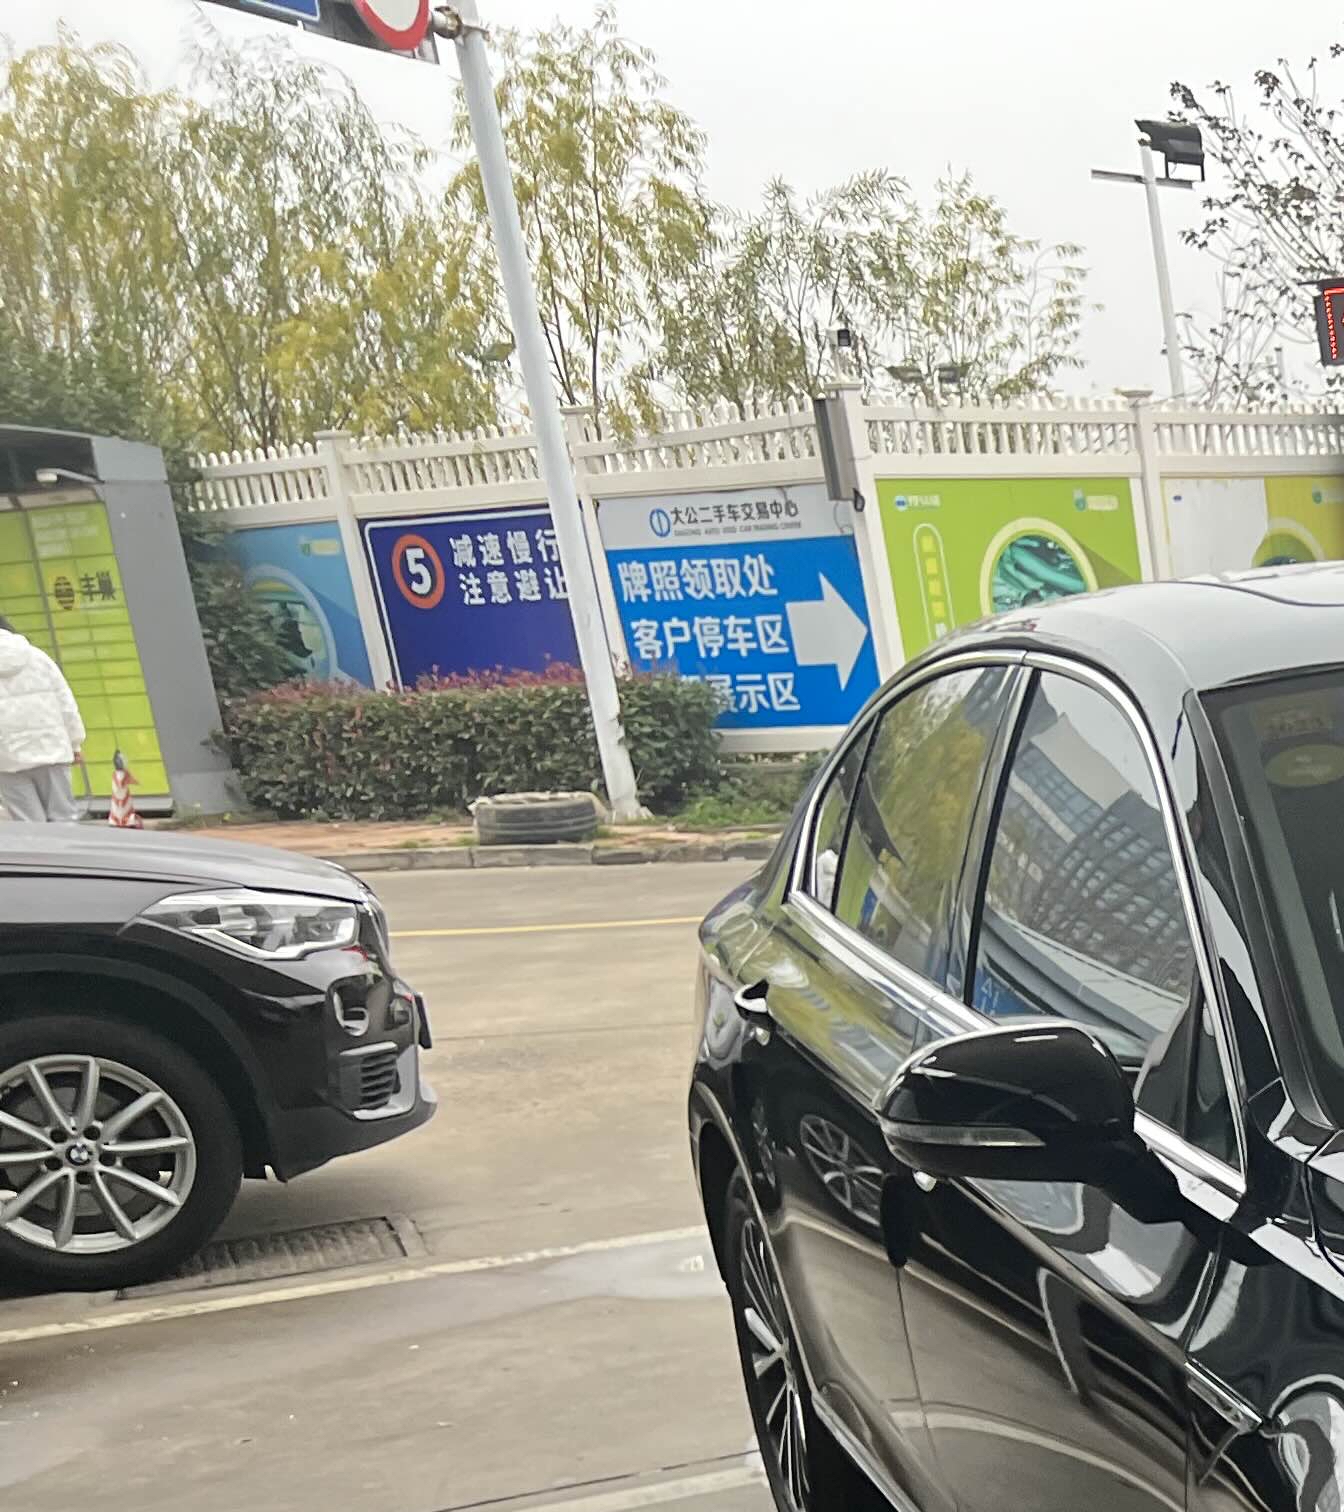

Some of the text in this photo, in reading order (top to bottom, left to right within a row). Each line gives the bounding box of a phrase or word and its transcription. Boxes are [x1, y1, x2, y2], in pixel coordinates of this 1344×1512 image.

[669, 500, 799, 526] 大公二手车交易中心
[405, 547, 433, 595] 5
[449, 528, 559, 568] 减速慢行
[616, 553, 779, 604] 牌照领取处
[630, 613, 790, 660] 客户停车区
